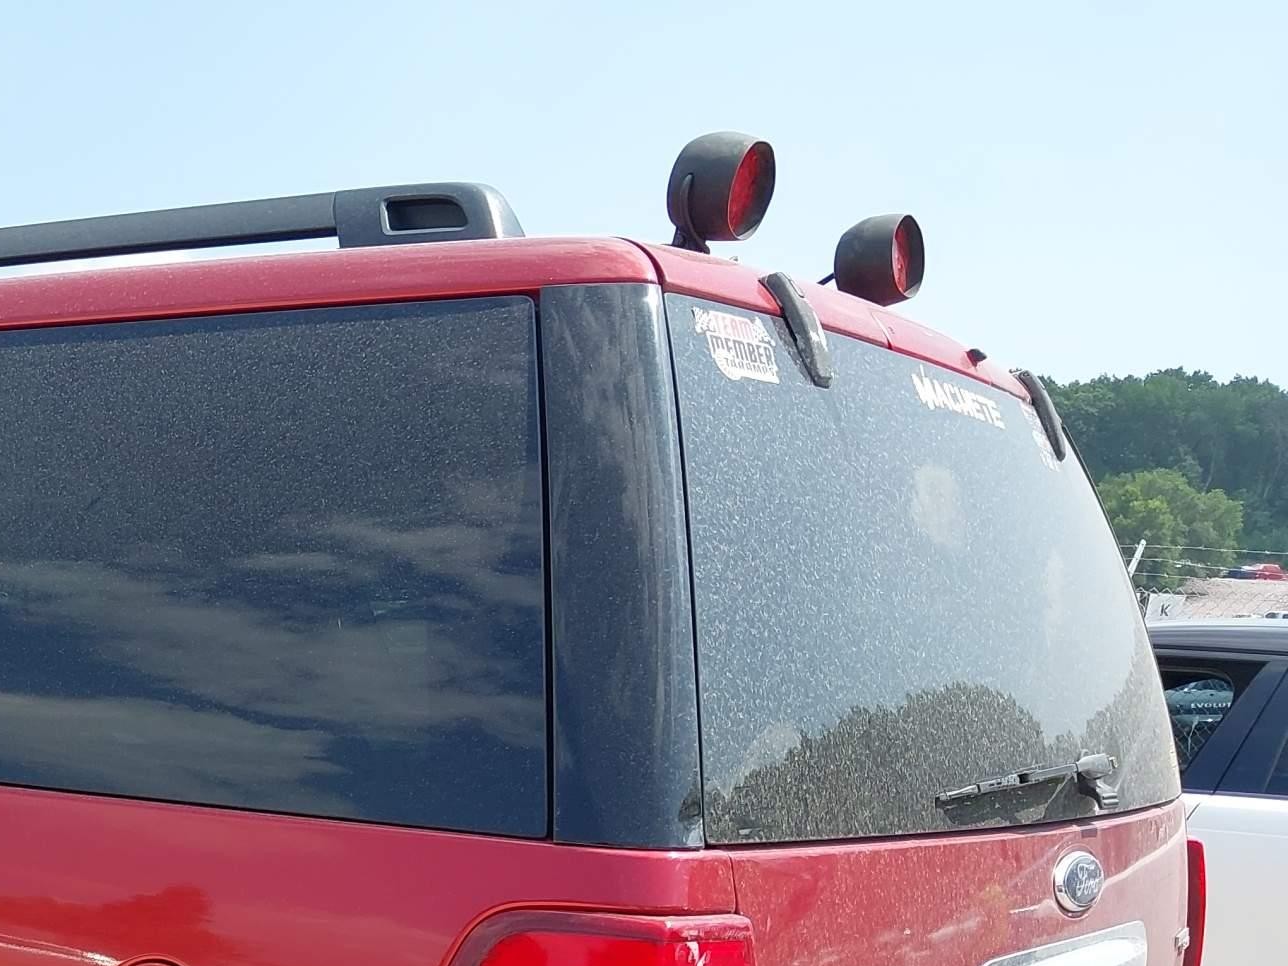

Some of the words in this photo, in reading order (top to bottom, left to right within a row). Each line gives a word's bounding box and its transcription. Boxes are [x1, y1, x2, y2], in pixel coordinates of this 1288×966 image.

[709, 334, 774, 367] MEMBER
[911, 363, 1006, 430] MACHETE
[1075, 862, 1101, 897] Ford
